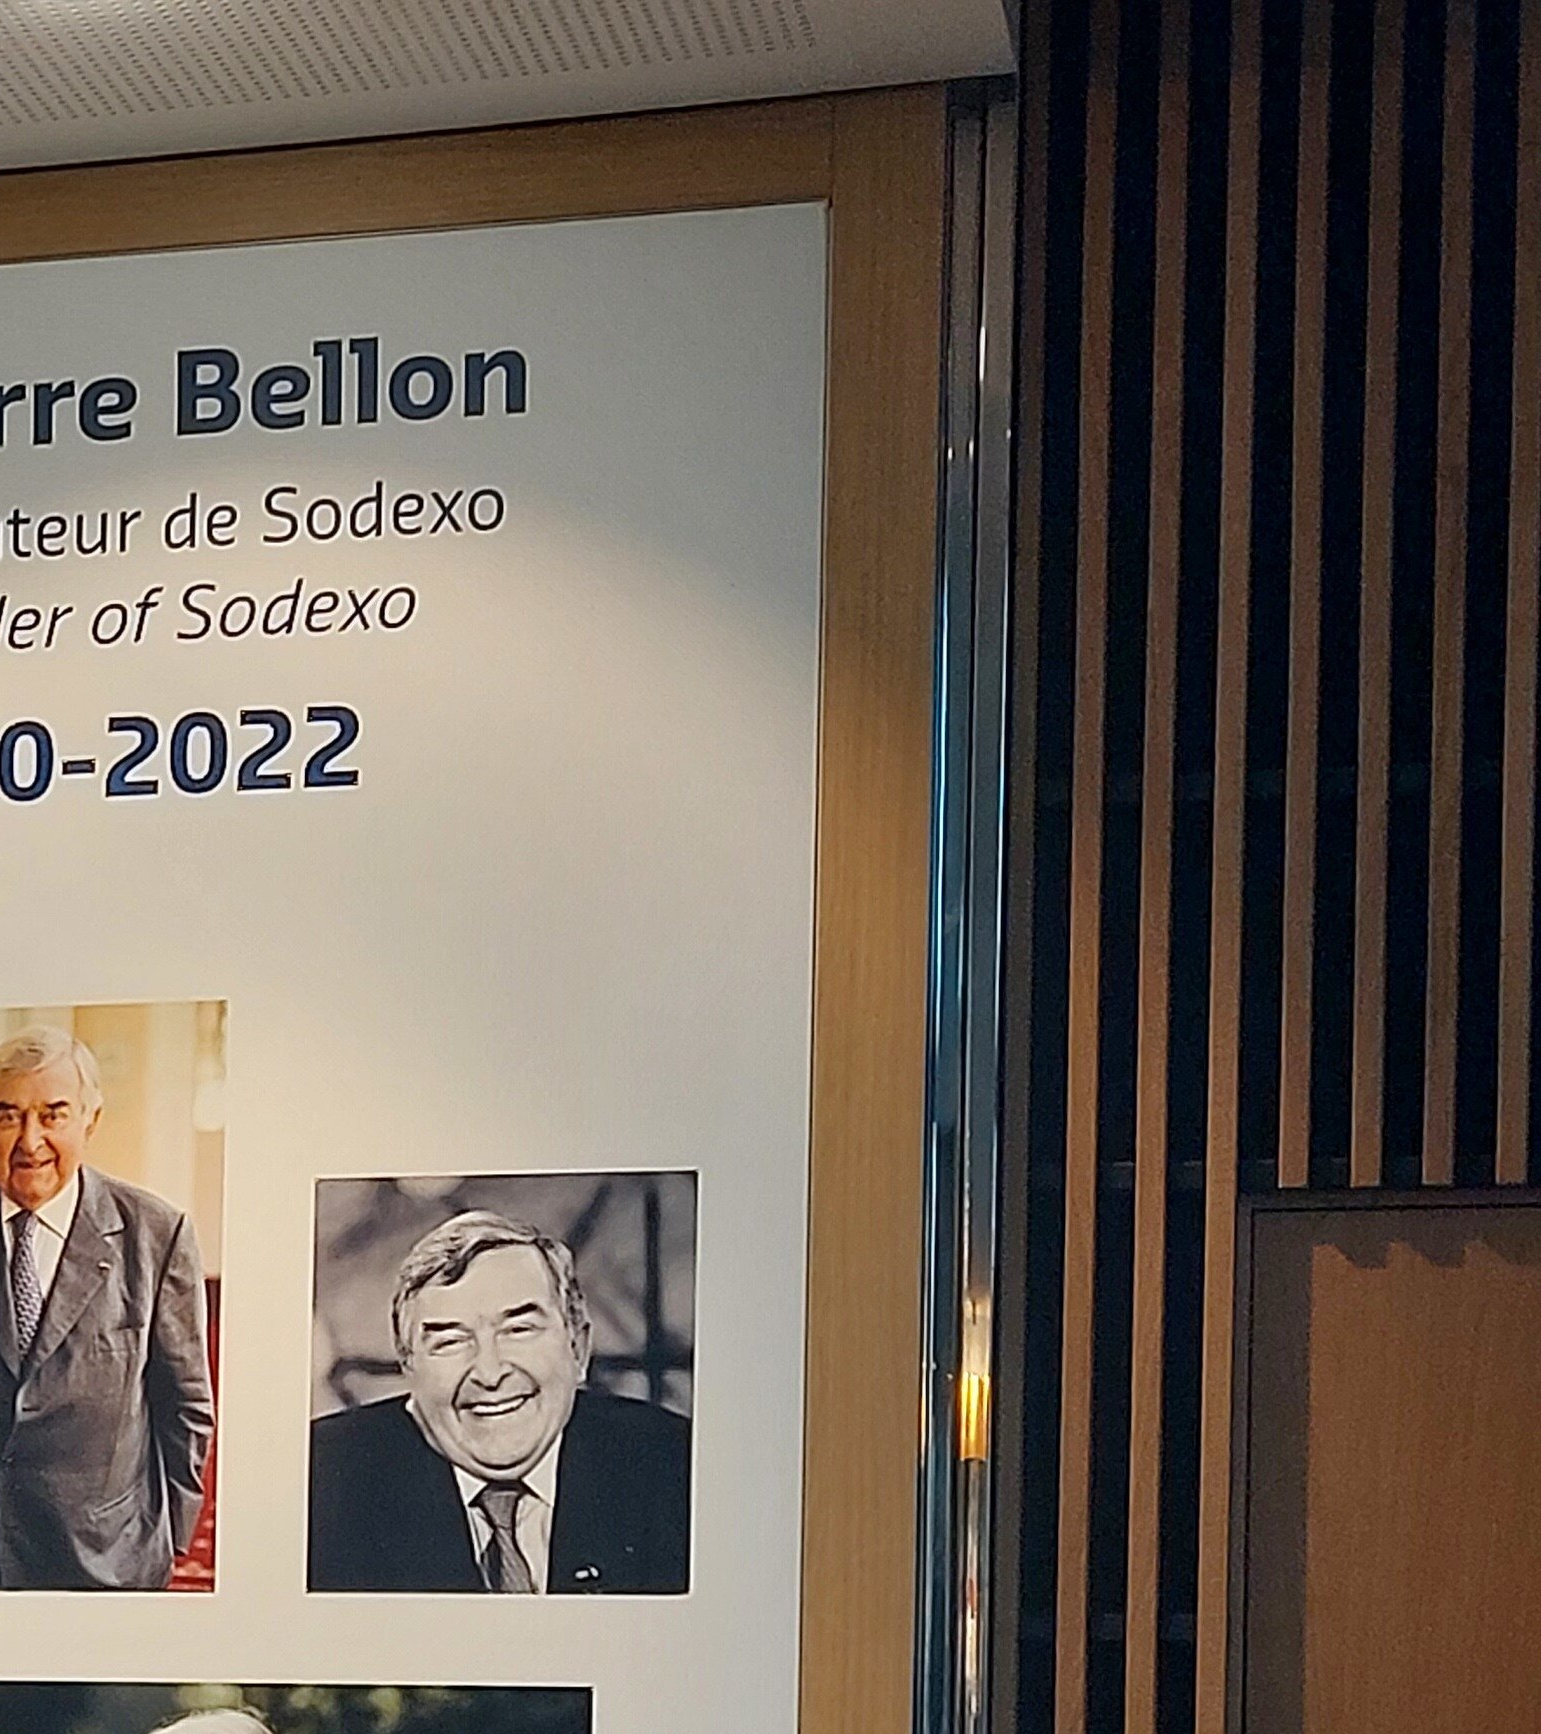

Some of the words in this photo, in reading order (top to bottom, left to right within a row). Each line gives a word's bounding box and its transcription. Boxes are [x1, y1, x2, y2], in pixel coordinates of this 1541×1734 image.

[176, 337, 529, 436] Bellon
[164, 493, 238, 548] de
[262, 481, 505, 544] Sodexo
[91, 587, 164, 647] of
[177, 579, 417, 640] Sodexo
